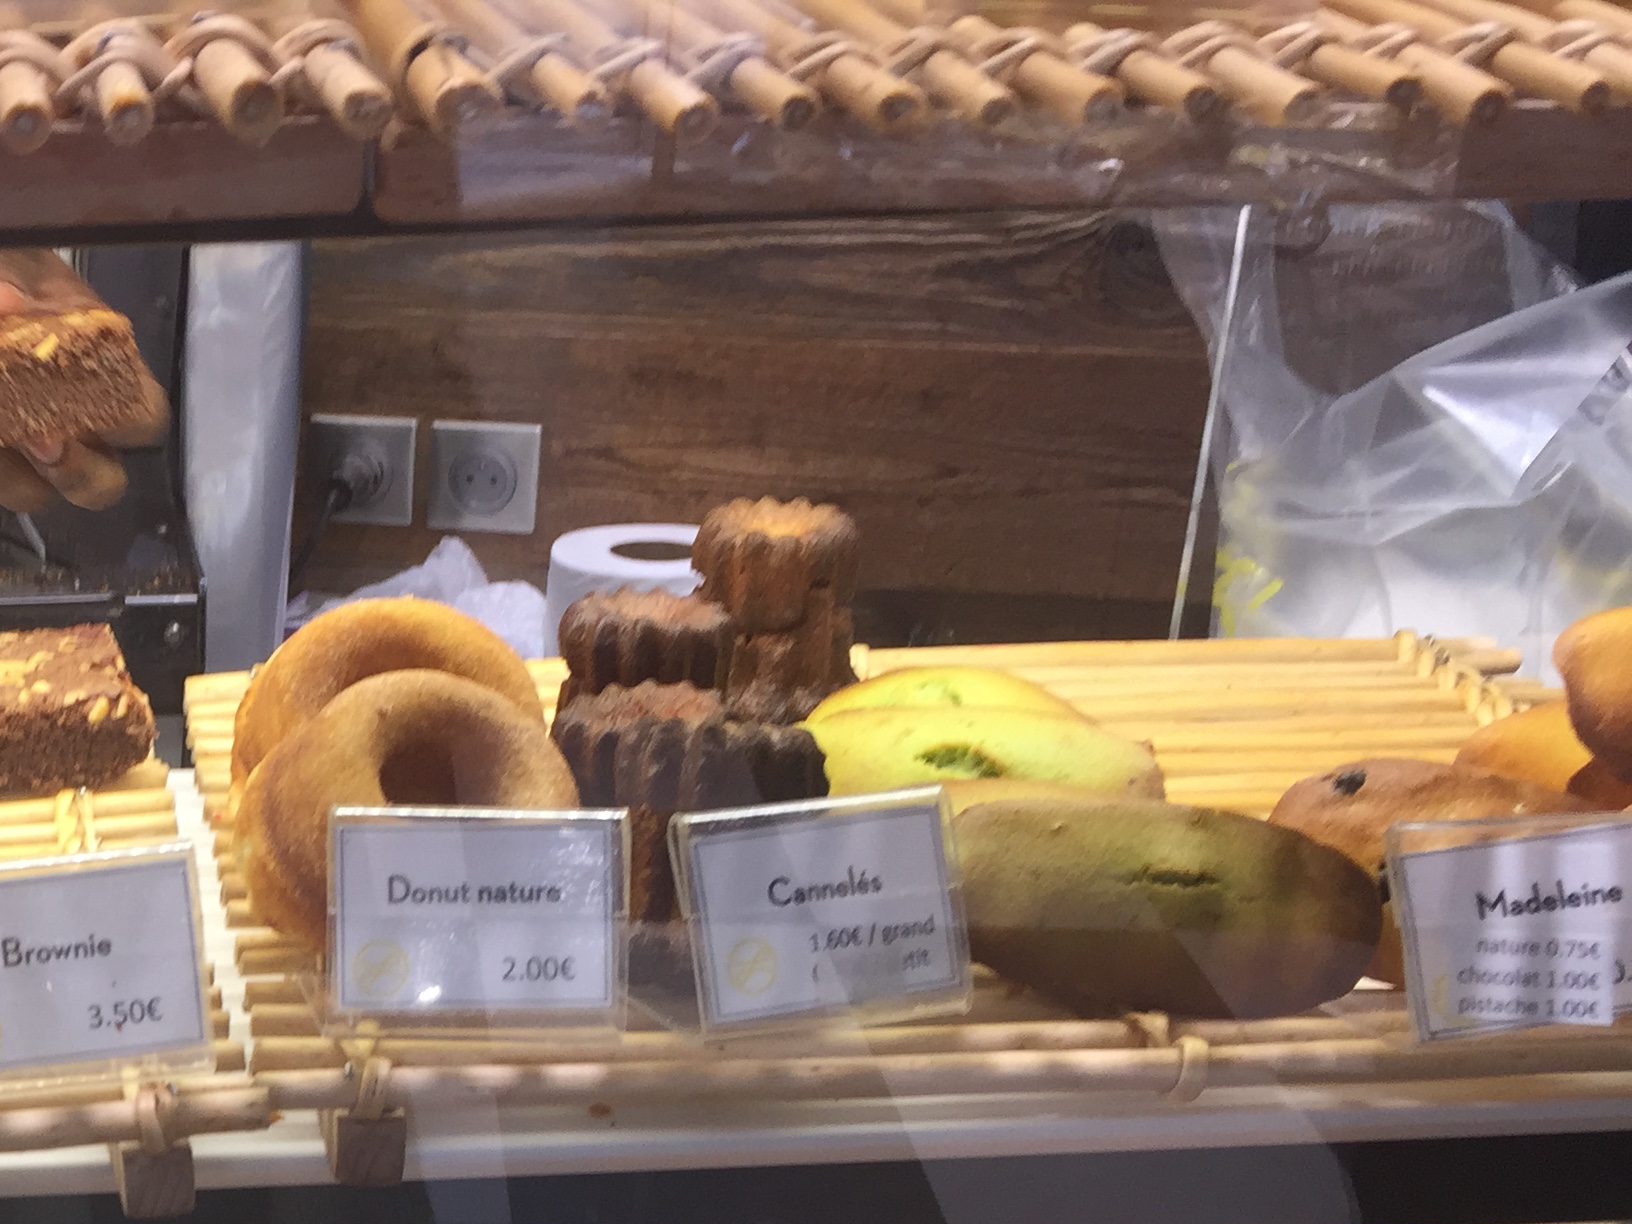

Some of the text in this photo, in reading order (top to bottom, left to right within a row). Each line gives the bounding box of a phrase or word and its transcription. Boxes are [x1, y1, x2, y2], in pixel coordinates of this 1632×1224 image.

[387, 874, 562, 905] Donut nature
[767, 864, 883, 907] Cannelés
[1475, 879, 1624, 920] Madeleine
[881, 913, 937, 946] grand
[0, 933, 113, 968] Brownie
[501, 955, 576, 983] 2.00€
[87, 995, 165, 1031] 3.50€
